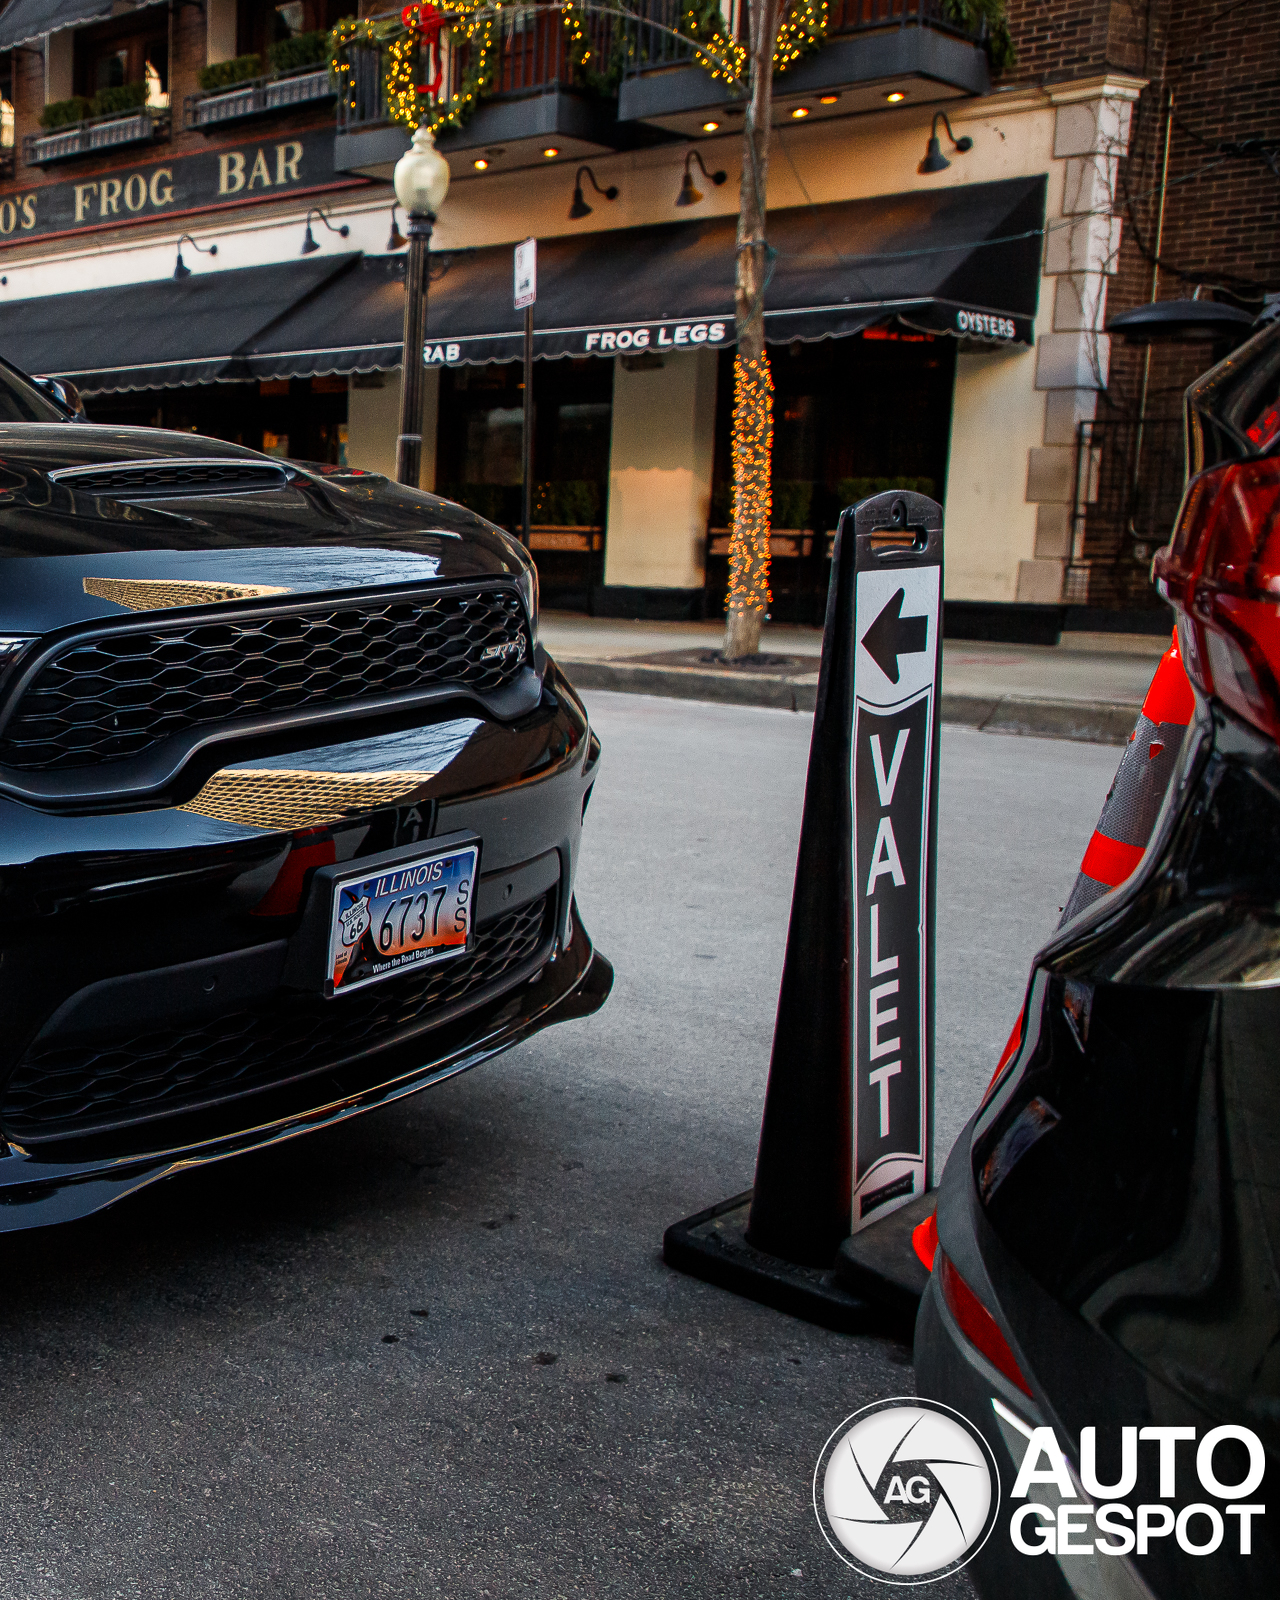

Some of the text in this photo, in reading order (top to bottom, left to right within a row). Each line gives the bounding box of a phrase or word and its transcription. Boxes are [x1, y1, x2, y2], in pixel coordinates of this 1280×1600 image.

[74, 167, 175, 223] FROG
[218, 140, 304, 195] BAR
[585, 322, 726, 352] FROG LEGS
[957, 310, 1016, 339] OYSTERS
[423, 343, 461, 363] RAB
[375, 862, 444, 898] ILLINOIS
[349, 918, 364, 940] 66
[379, 884, 448, 951] 6737
[866, 727, 910, 1138] VALET
[372, 947, 434, 973] Where the Road Begins
